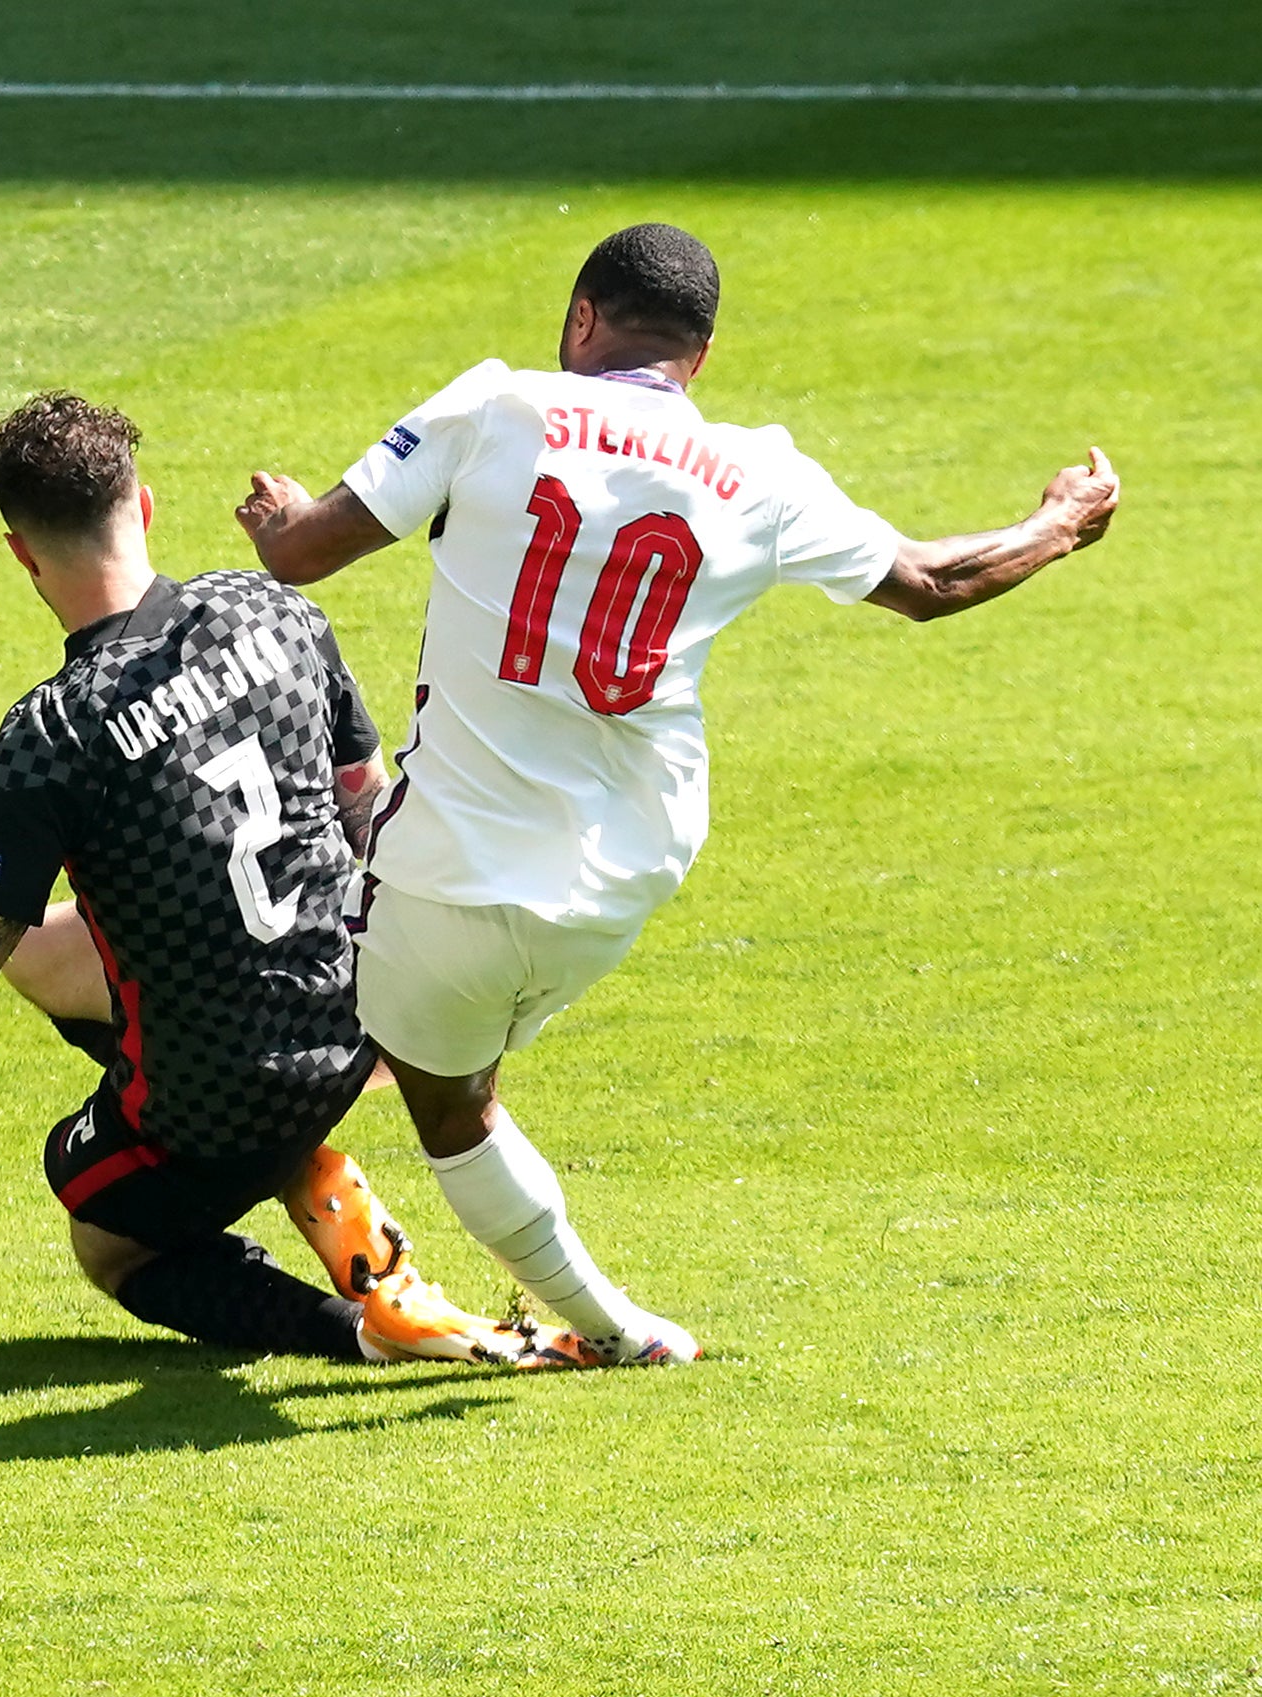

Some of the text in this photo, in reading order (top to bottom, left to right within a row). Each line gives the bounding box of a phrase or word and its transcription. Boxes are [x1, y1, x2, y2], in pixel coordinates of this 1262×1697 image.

[545, 407, 745, 500] STERLING
[499, 474, 703, 715] 10
[194, 732, 306, 945] 2
